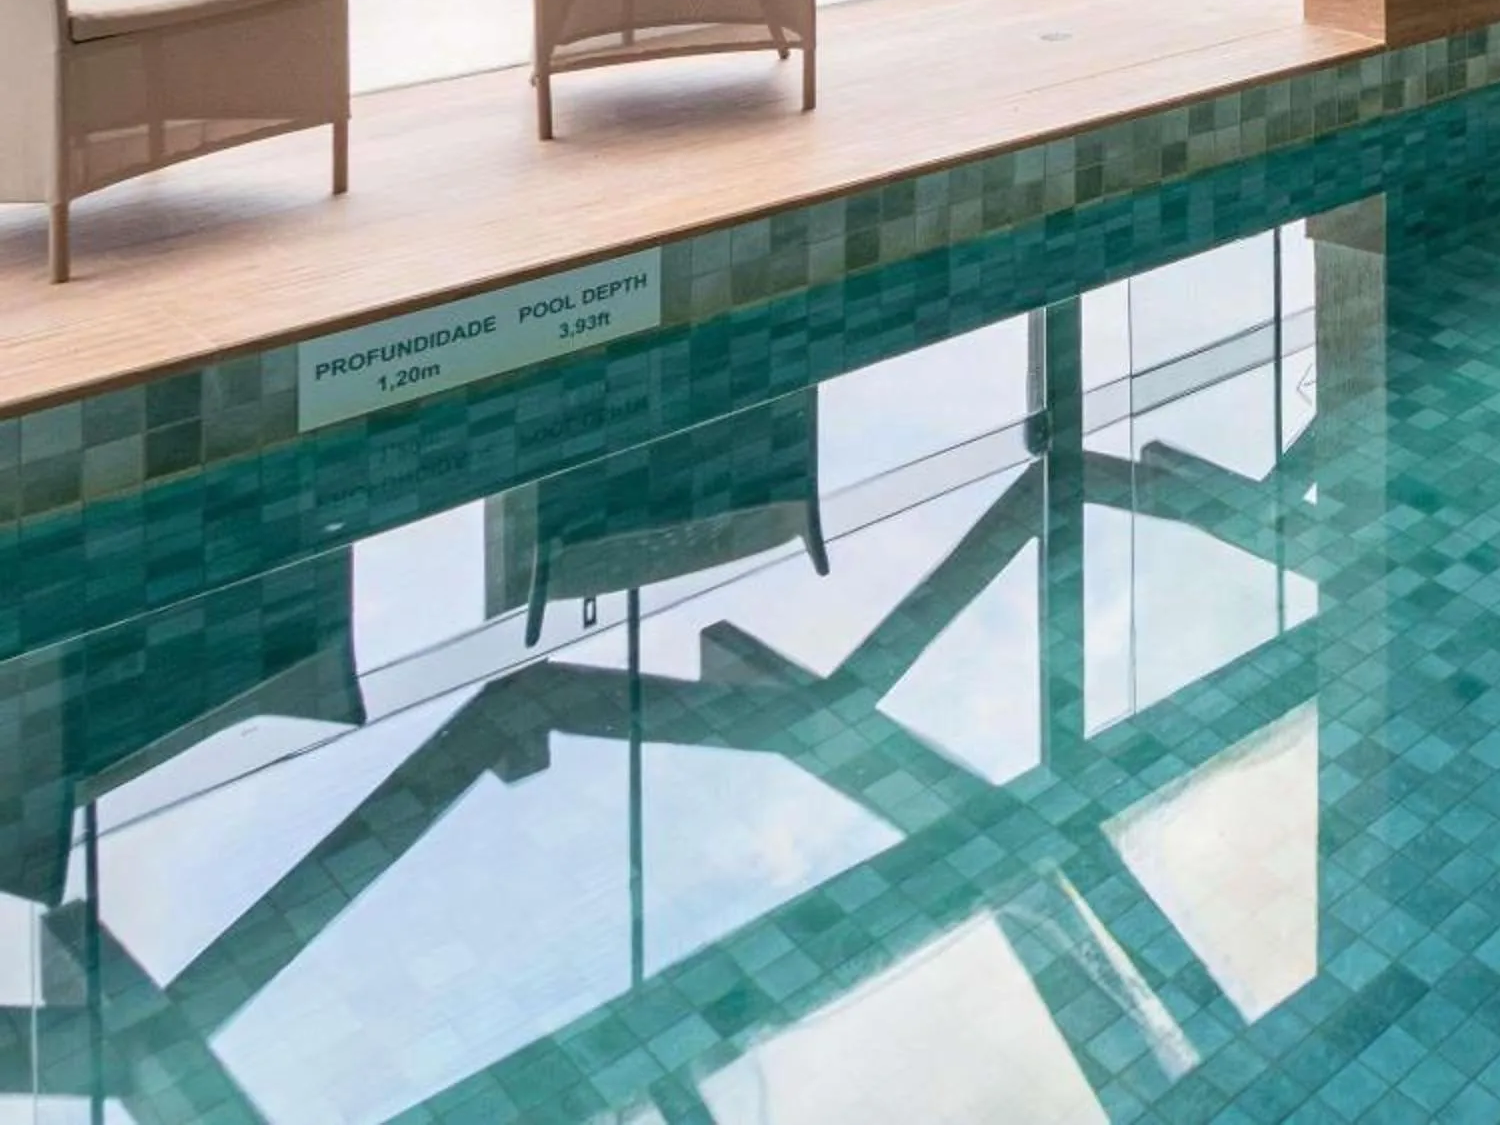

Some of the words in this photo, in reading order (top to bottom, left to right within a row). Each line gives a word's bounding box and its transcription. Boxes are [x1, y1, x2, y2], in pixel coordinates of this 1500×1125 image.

[315, 315, 497, 381] PROFUNDIDADE
[518, 295, 576, 324] POOL
[582, 273, 647, 305] DEPTH
[377, 363, 441, 392] 1,20m
[559, 311, 610, 340] 3,93ft
